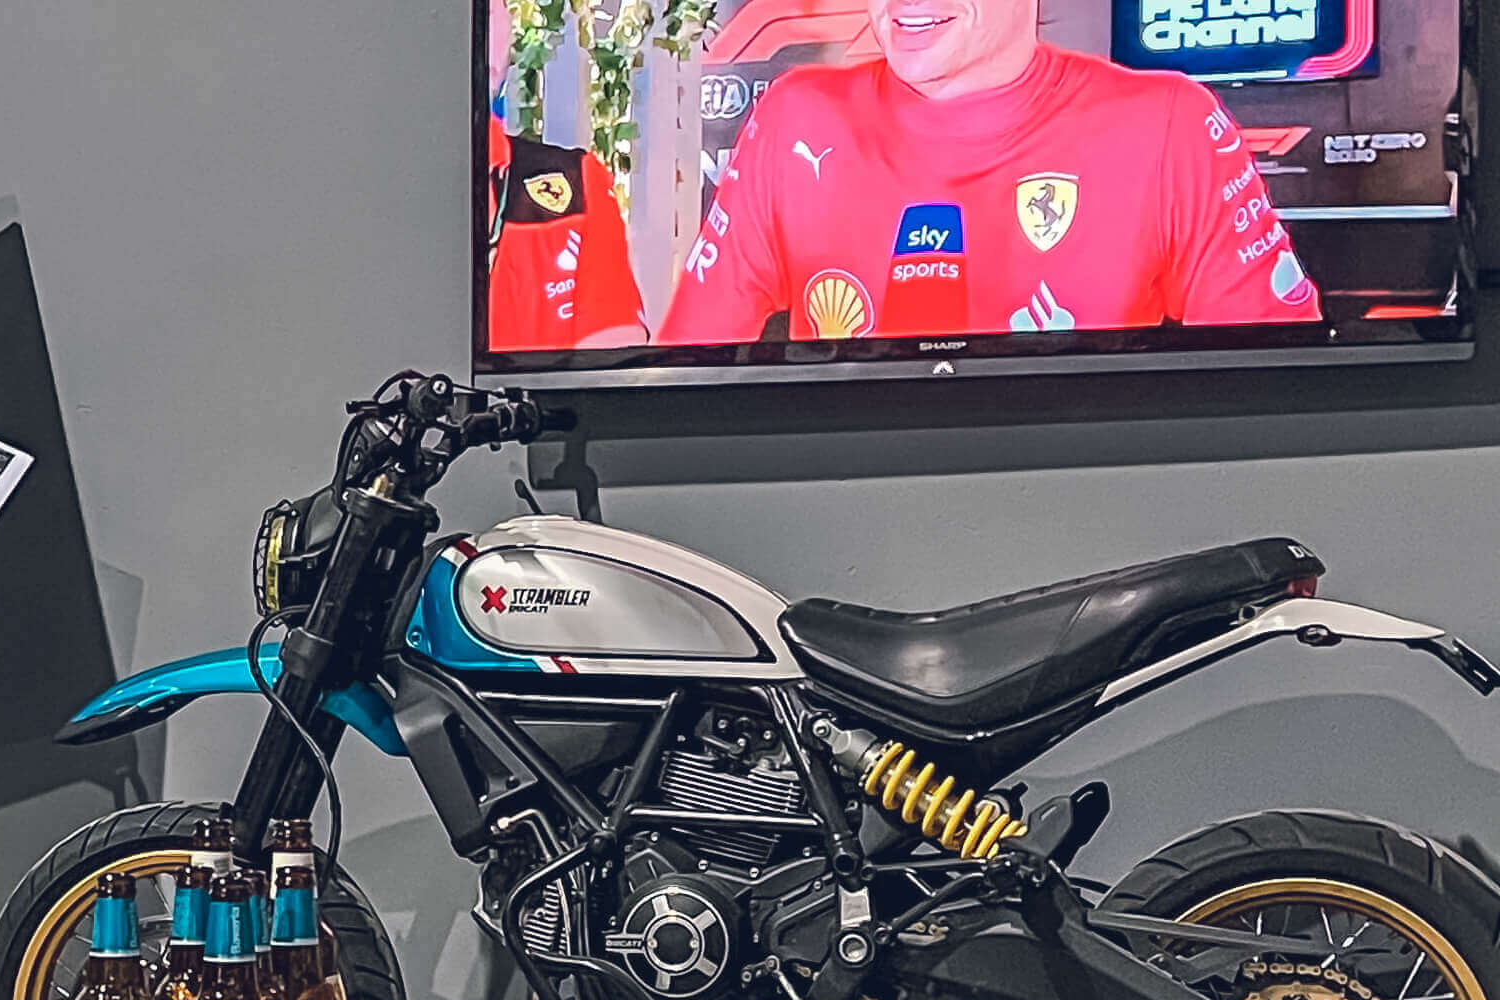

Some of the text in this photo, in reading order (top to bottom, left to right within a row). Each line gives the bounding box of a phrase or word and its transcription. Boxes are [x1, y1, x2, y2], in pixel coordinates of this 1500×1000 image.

[907, 225, 950, 250] sky
[892, 261, 960, 281] sports
[919, 341, 968, 351] SHARP
[510, 588, 591, 606] SCRAMBLER
[508, 605, 548, 613] DUCATI
